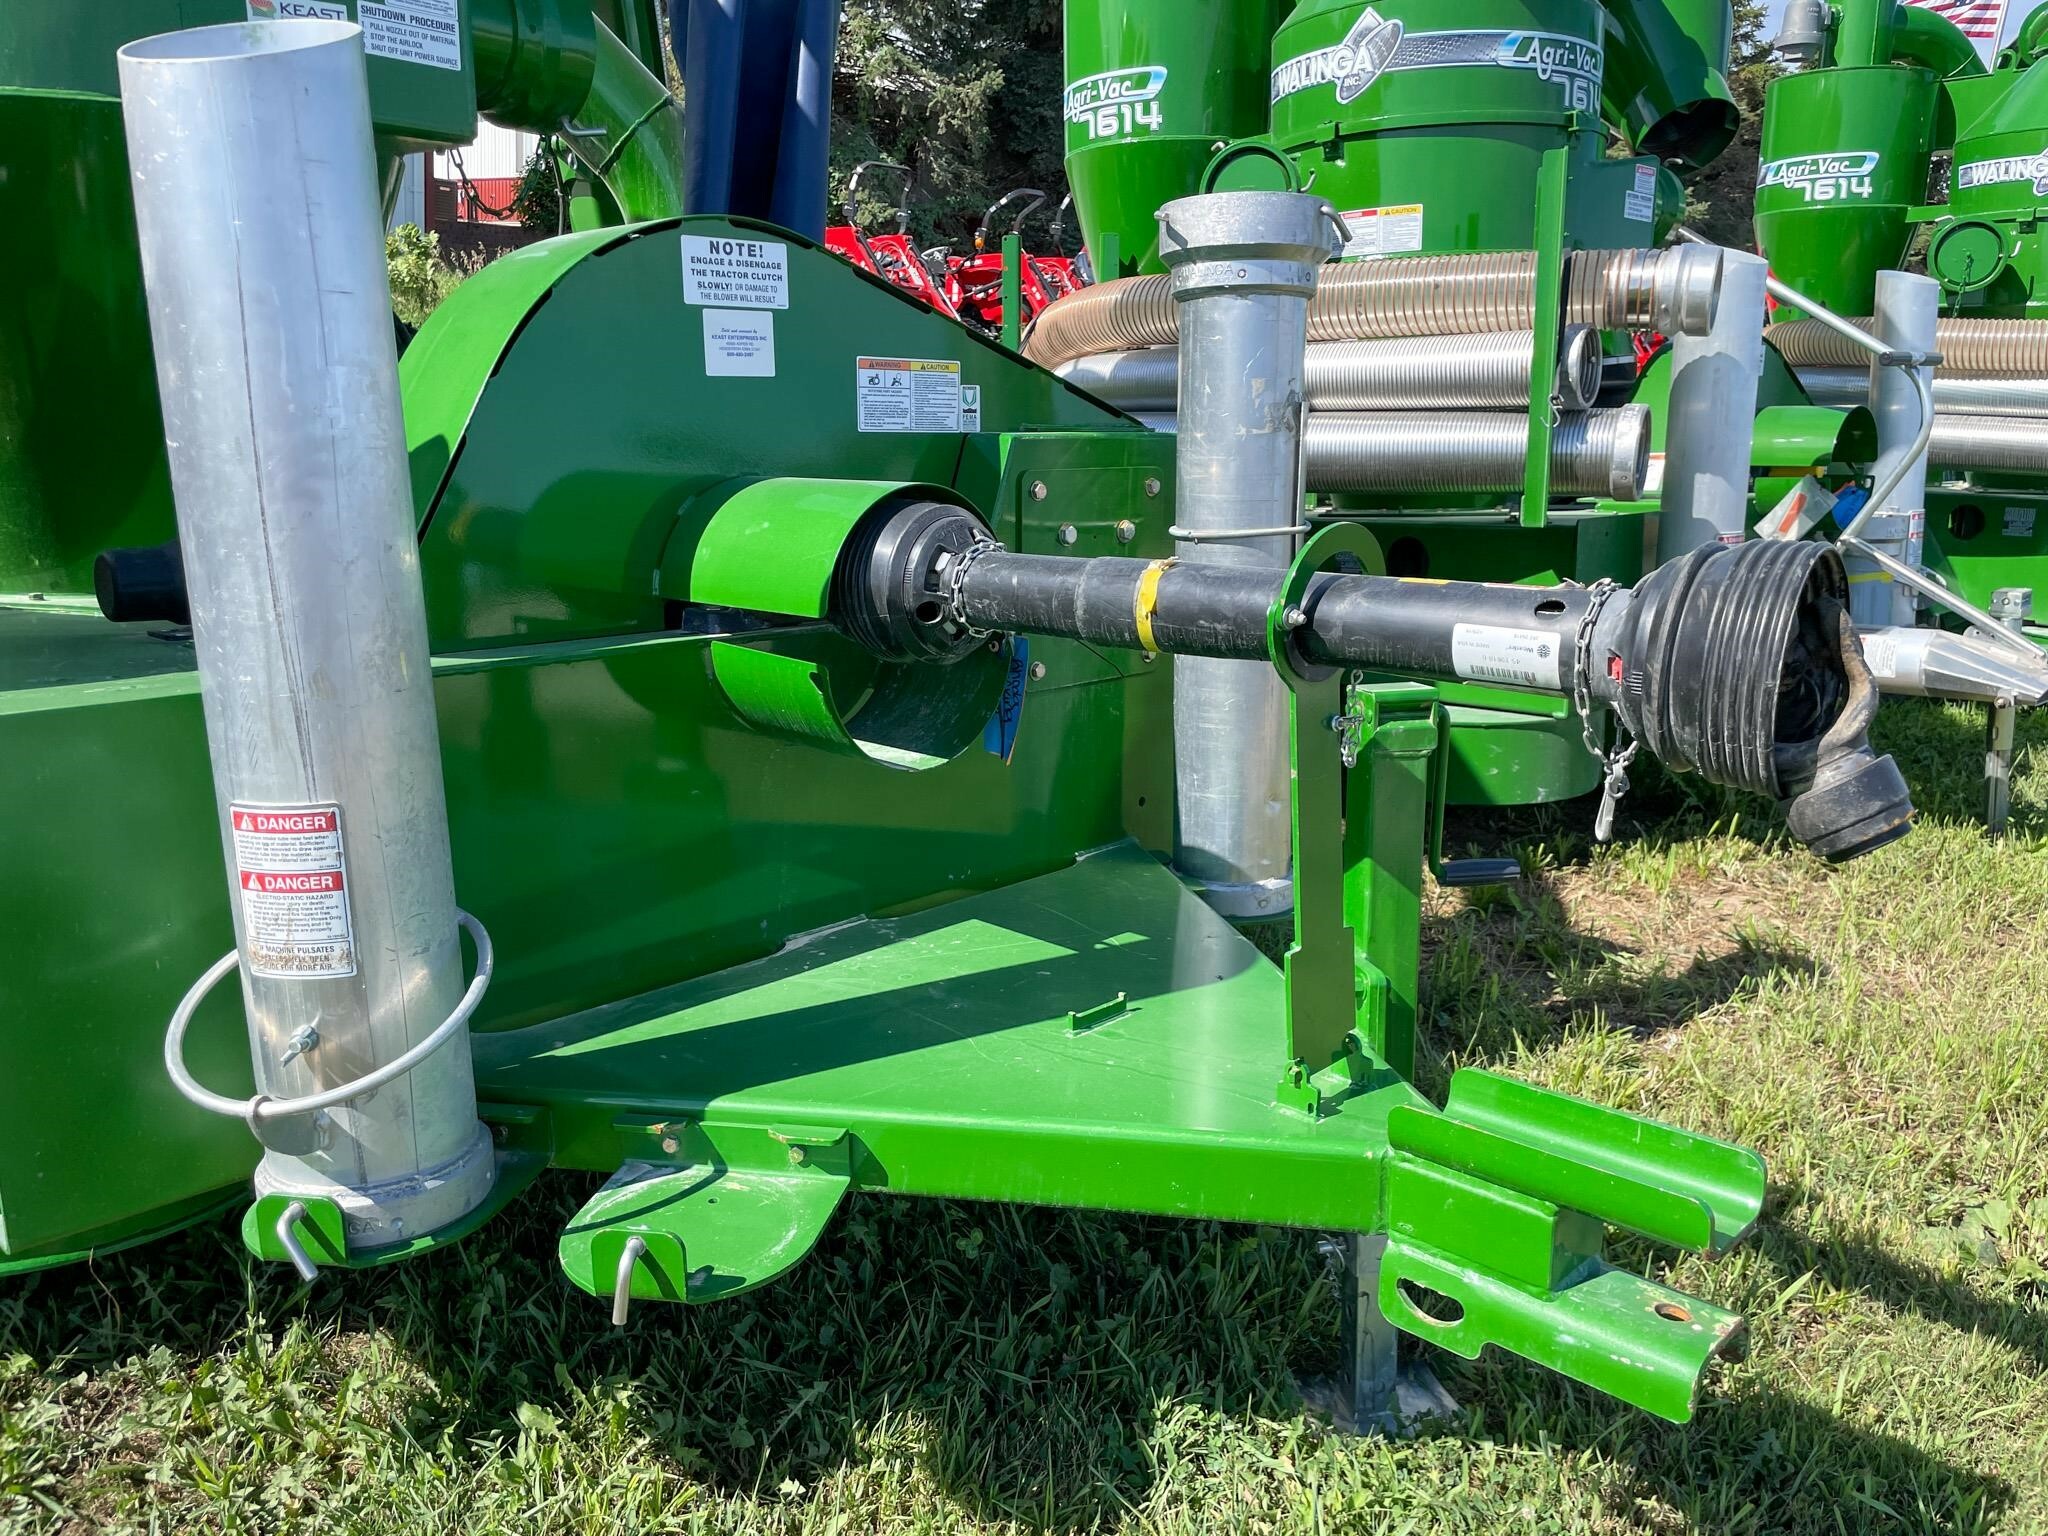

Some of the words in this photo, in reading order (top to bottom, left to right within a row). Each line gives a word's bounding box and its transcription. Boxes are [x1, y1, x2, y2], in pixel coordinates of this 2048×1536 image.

[279, 1, 345, 20] KEAST
[360, 4, 406, 23] SHUTDOWN
[409, 15, 456, 33] PROCEDURE
[369, 21, 385, 32] PULL
[385, 24, 407, 37] NOZZLE
[408, 29, 420, 39] OUT
[420, 32, 429, 41] OF
[430, 33, 457, 47] MATERIAL
[370, 32, 386, 42] STOP
[386, 35, 398, 45] THE
[398, 37, 423, 50] AIRLOCK
[370, 43, 386, 53] SHUT
[387, 45, 399, 55] OFF
[399, 48, 413, 58] UNIT
[414, 51, 436, 63] POWER
[436, 55, 458, 67] SOURCE
[1525, 37, 1597, 80] Agri-Vac
[1277, 45, 1374, 96] WALINGA
[1343, 76, 1361, 87] INC.
[1066, 77, 1132, 122] Agri-Vac
[1078, 101, 1163, 140] 7614
[1777, 158, 1850, 188] Agri-Vac
[1971, 156, 2048, 186] WALING
[1792, 177, 1873, 202] 7614
[709, 240, 764, 258] NOTE!
[690, 256, 725, 266] ENGAGE
[736, 260, 782, 270] DISENGAGE
[690, 268, 707, 277] THE
[710, 270, 749, 279] TRACTOR
[751, 273, 783, 282] CLUTCH
[697, 281, 733, 291] SLOWLY!
[735, 283, 744, 291] OR
[745, 284, 768, 293] DAMAGE
[700, 292, 712, 300] THE
[713, 293, 738, 301] BLOWER
[740, 294, 753, 302] WILL
[754, 296, 776, 304] RESULT
[875, 361, 902, 369] WARNING
[257, 816, 327, 831] DANGER
[264, 876, 334, 891] DANGER
[265, 945, 296, 954] MACHINE
[297, 945, 335, 954] PULSATES
[280, 962, 294, 971] FOR
[295, 962, 317, 972] MORE
